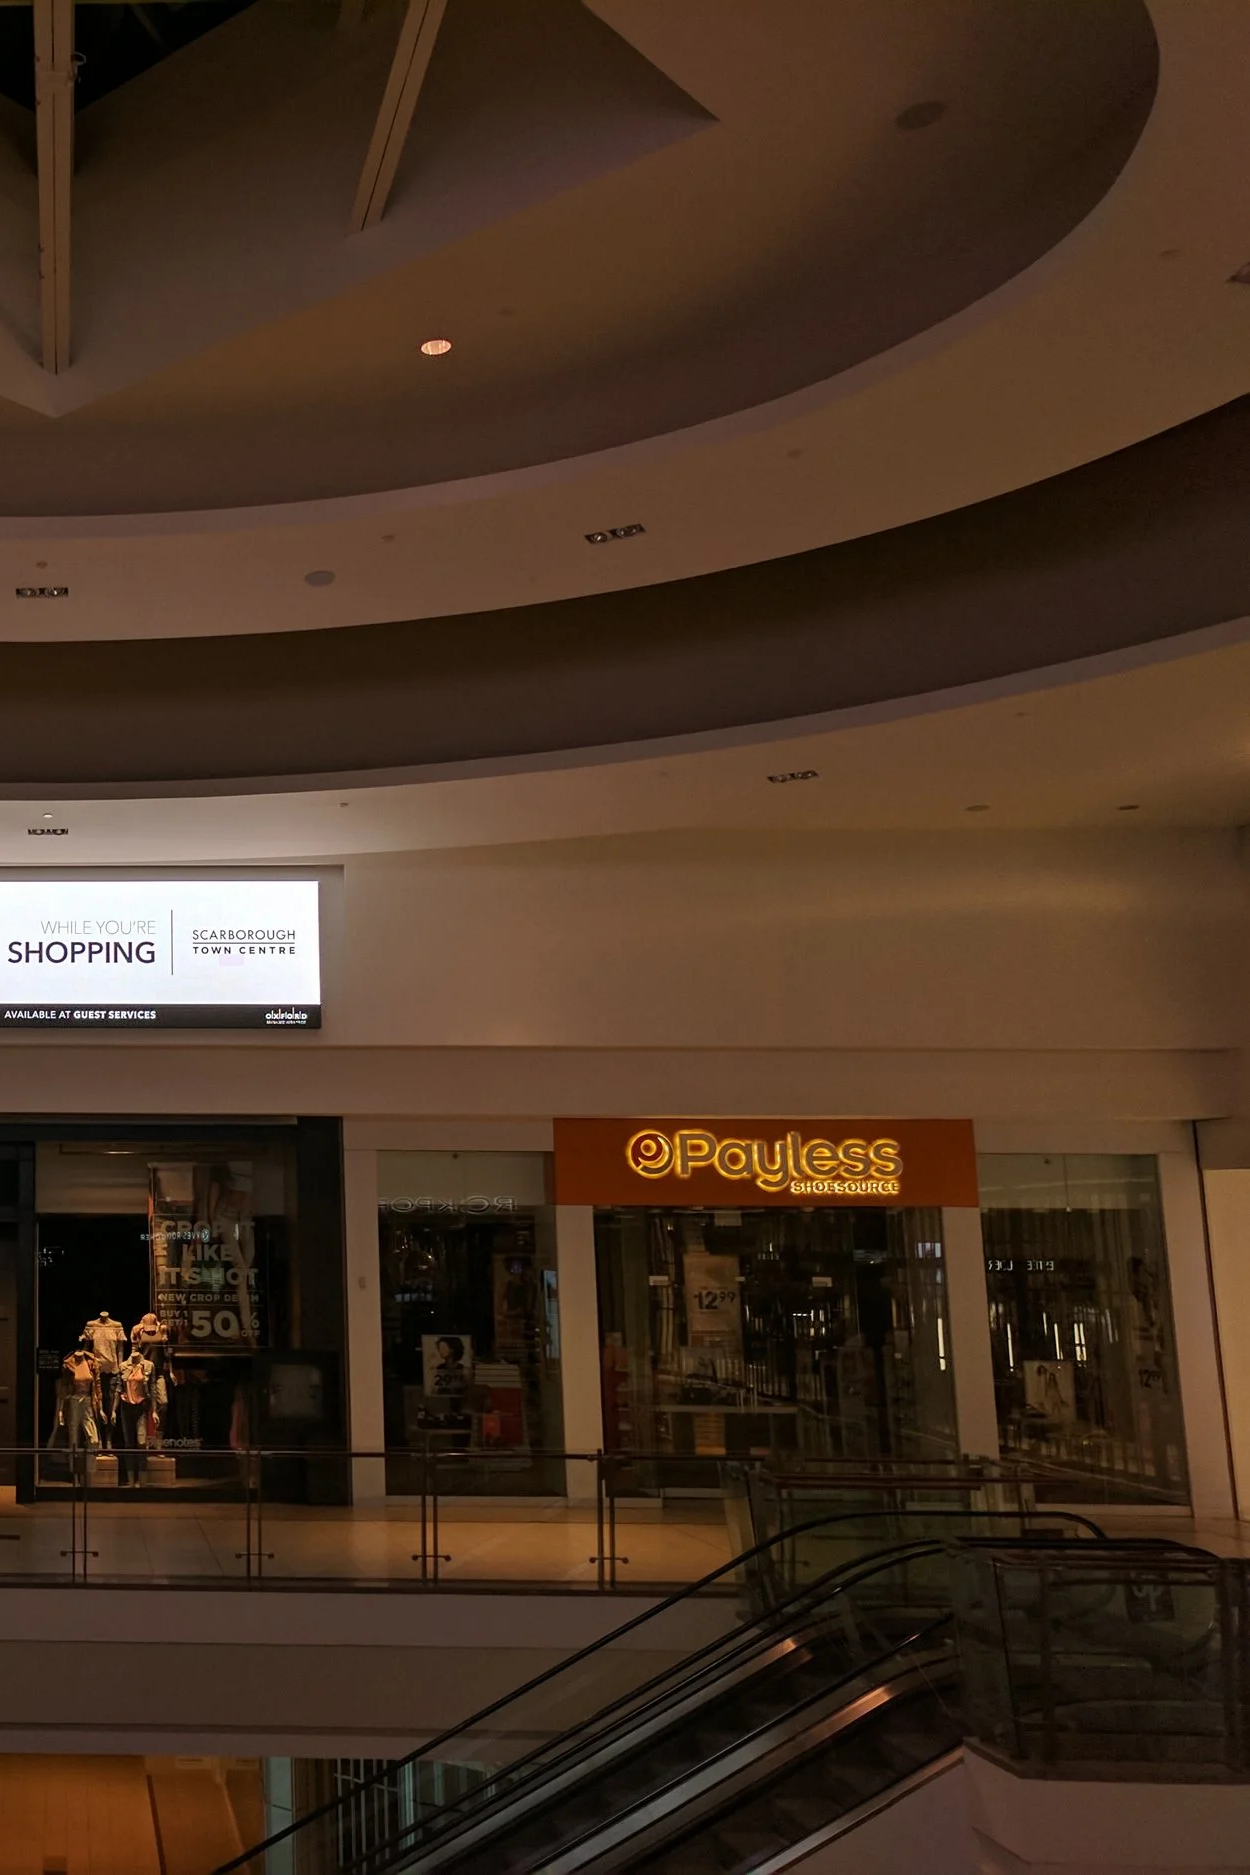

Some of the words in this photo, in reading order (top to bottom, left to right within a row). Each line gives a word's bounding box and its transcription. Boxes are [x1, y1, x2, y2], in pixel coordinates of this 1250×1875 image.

[40, 920, 92, 934] WHILE
[95, 920, 157, 935] YOU'RE
[192, 929, 296, 940] SCARBOROUGH
[7, 941, 156, 964] SHOPPING
[192, 946, 232, 954] TOWN
[238, 946, 296, 954] CENTRE
[4, 1010, 57, 1019] AVAILABLE
[58, 1010, 71, 1019] AT
[73, 1010, 106, 1019] GUEST
[108, 1010, 157, 1019] SERVICES
[675, 1129, 903, 1192] Payless
[789, 1179, 901, 1195] SHOESOURCE
[182, 1243, 234, 1262] LIKE
[158, 1293, 187, 1302] NEW
[190, 1293, 221, 1302] CROP
[159, 1310, 181, 1318] BUY
